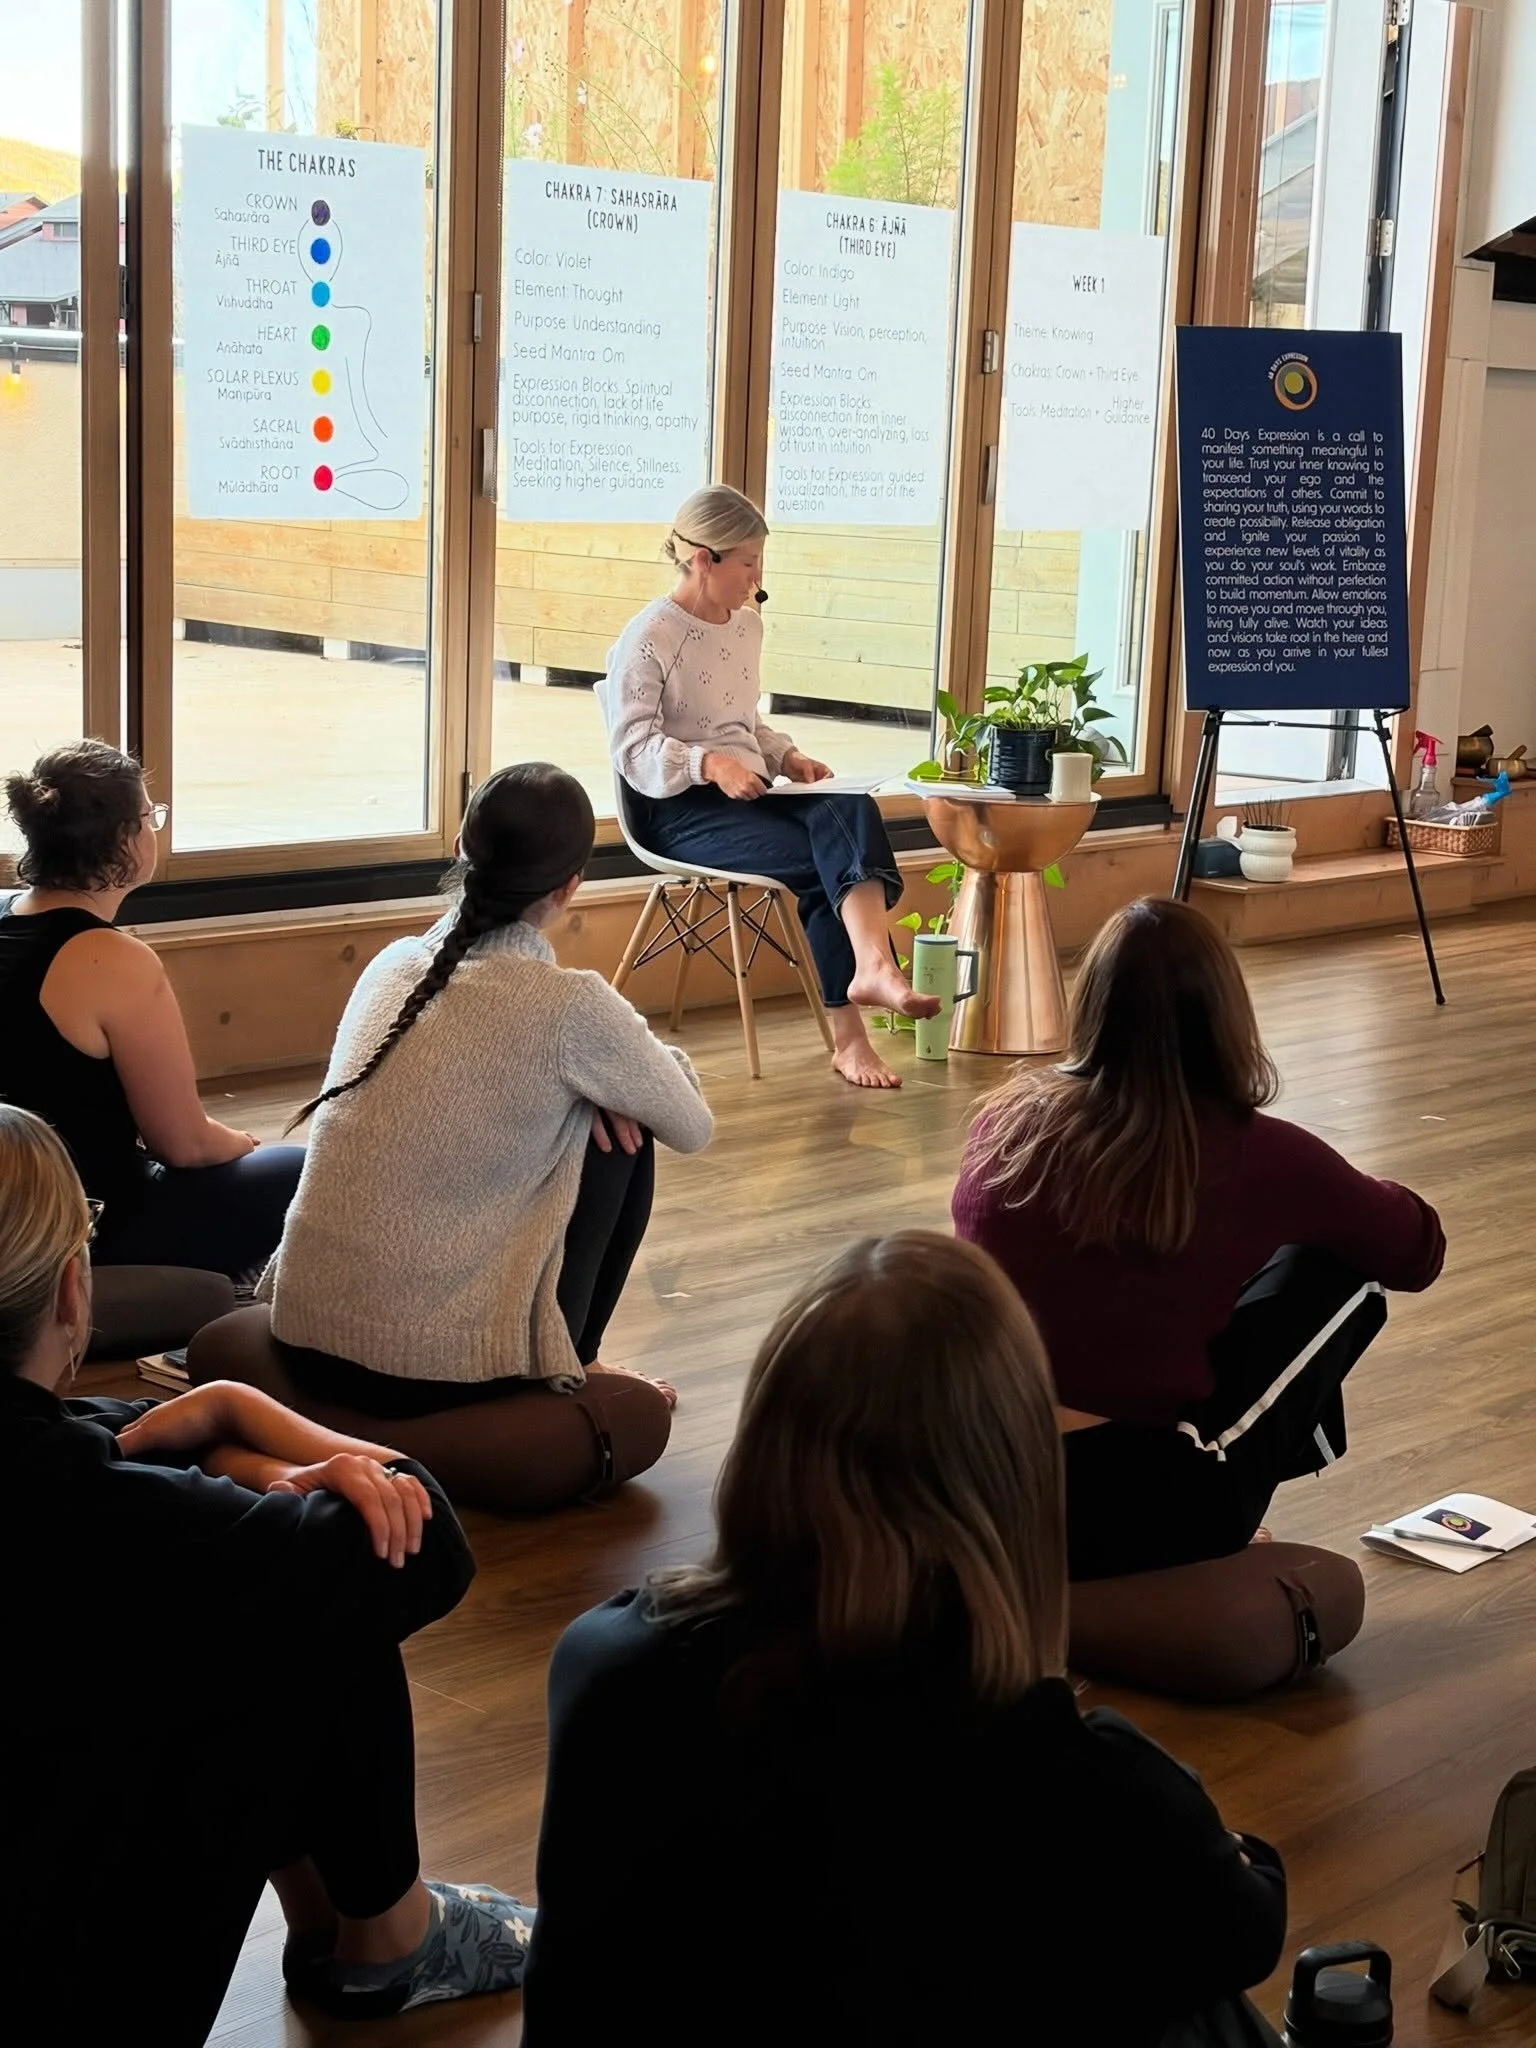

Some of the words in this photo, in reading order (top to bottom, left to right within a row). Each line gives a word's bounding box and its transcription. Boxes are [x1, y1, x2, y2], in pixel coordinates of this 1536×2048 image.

[258, 150, 282, 171] THE
[289, 153, 356, 177] CHAKRAS
[545, 181, 591, 202] CHAKRA
[246, 193, 298, 211] CROWN
[588, 209, 639, 233] (CROWN)
[826, 212, 864, 231] CHAKRA
[231, 236, 269, 252] THIRD
[274, 239, 296, 255] EYE
[839, 237, 871, 256] (THIRD
[874, 241, 896, 259] EYE)
[556, 253, 592, 269] Violet
[819, 264, 855, 282] Indigo
[246, 279, 297, 295] THROAT
[1073, 275, 1097, 293] WEEK
[1101, 279, 1105, 293] 1
[216, 296, 273, 309] Vishuddha
[573, 284, 623, 306] Thought
[833, 293, 860, 311] Light
[258, 327, 297, 342] HEART
[573, 317, 661, 338] Understanding
[781, 335, 825, 350] intuition
[513, 343, 546, 359] Seed
[603, 348, 625, 364] Om
[208, 369, 248, 384] SOLAR
[254, 371, 299, 385] PLEXUS
[780, 362, 810, 377] Seed
[513, 374, 578, 392] Expression
[625, 379, 672, 396] Spiritual
[604, 395, 627, 409] lack
[632, 396, 644, 410] of
[646, 396, 663, 412] life
[780, 391, 837, 408] Expression
[573, 412, 600, 427] rigid
[656, 414, 698, 432] apathy
[780, 408, 852, 422] disconnection
[856, 410, 879, 424] from
[882, 411, 906, 425] inner
[254, 419, 300, 433] SACRAL
[912, 430, 930, 441] loss
[1201, 428, 1215, 440] 40
[1224, 428, 1250, 442] Days
[1258, 429, 1309, 443] Expression
[1318, 429, 1324, 441] is
[1332, 432, 1342, 441] a
[1348, 429, 1364, 441] call
[1373, 430, 1383, 441] to
[513, 438, 545, 454] Tools
[550, 439, 565, 454] for
[794, 441, 815, 452] trust
[831, 442, 871, 454] intuition
[1201, 443, 1243, 455] manifest
[1251, 444, 1303, 457] something
[1312, 444, 1367, 458] meaningful
[1374, 445, 1383, 456] in
[261, 466, 300, 480] ROOT
[1201, 460, 1224, 471] your
[1248, 458, 1269, 469] Trust
[1273, 461, 1295, 472] your
[1299, 458, 1324, 470] inner
[1327, 459, 1369, 473] knowing
[1374, 459, 1384, 471] to
[513, 473, 561, 492] Seeking
[565, 475, 606, 492] higher
[609, 474, 665, 492] guidance
[779, 466, 807, 480] Tools
[889, 469, 924, 485] guided
[1202, 472, 1250, 484] transcend
[1264, 475, 1286, 486] your
[1299, 476, 1321, 487] ego
[1334, 473, 1354, 485] and
[1368, 473, 1384, 485] the
[1202, 486, 1266, 500] expectations
[1274, 487, 1284, 498] of
[1330, 488, 1367, 499] Commit
[1374, 488, 1384, 499] to
[1203, 503, 1240, 516] sharing
[1242, 505, 1264, 516] your
[1266, 503, 1289, 516] truth,
[1291, 503, 1317, 516] using
[1319, 505, 1340, 516] your
[1342, 503, 1373, 514] words
[1374, 503, 1384, 514] to
[1203, 516, 1235, 527] create
[1291, 516, 1330, 528] Release
[1334, 516, 1384, 530] obligation
[1204, 530, 1225, 542] and
[1241, 530, 1269, 544] ignite
[1284, 533, 1306, 544] your
[1322, 531, 1360, 545] passion
[1375, 531, 1385, 542] to
[1204, 545, 1261, 559] experience
[1266, 548, 1288, 556] new
[1292, 545, 1320, 557] levels
[1324, 545, 1335, 557] of
[1339, 545, 1370, 559] vitality
[1374, 548, 1385, 557] as
[1204, 562, 1224, 573] you
[1230, 559, 1246, 571] do
[1250, 562, 1273, 573] your
[1342, 560, 1386, 571] Embrace
[1205, 574, 1258, 585] committed
[1263, 574, 1293, 585] action
[1297, 574, 1333, 585] without
[1338, 574, 1386, 588] perfection
[1206, 588, 1216, 600] to
[1220, 588, 1245, 600] build
[1311, 588, 1339, 600] Allow
[1342, 588, 1386, 600] emotions
[1206, 603, 1217, 614] to
[1219, 605, 1248, 614] move
[1250, 605, 1270, 616] you
[1272, 603, 1293, 614] and
[1295, 605, 1324, 614] move
[1326, 603, 1364, 616] through
[1366, 605, 1386, 616] you,
[1206, 617, 1233, 631] living
[1239, 617, 1258, 631] fully
[1295, 617, 1327, 629] Watch
[1332, 620, 1354, 631] your
[1360, 617, 1388, 629] ideas
[1207, 631, 1228, 643] and
[1230, 631, 1263, 643] visions
[1265, 631, 1287, 643] take
[1289, 631, 1309, 643] root
[1312, 631, 1321, 643] in
[1323, 631, 1339, 643] the
[1342, 631, 1364, 643] here
[1367, 631, 1387, 643] and
[1208, 649, 1230, 657] now
[1237, 649, 1250, 657] as
[1256, 648, 1275, 660] you
[1282, 646, 1311, 657] arrive
[1318, 646, 1326, 657] in
[1333, 648, 1355, 659] your
[1362, 645, 1388, 657] fullest
[1208, 660, 1260, 674] expression
[1262, 660, 1273, 672] of
